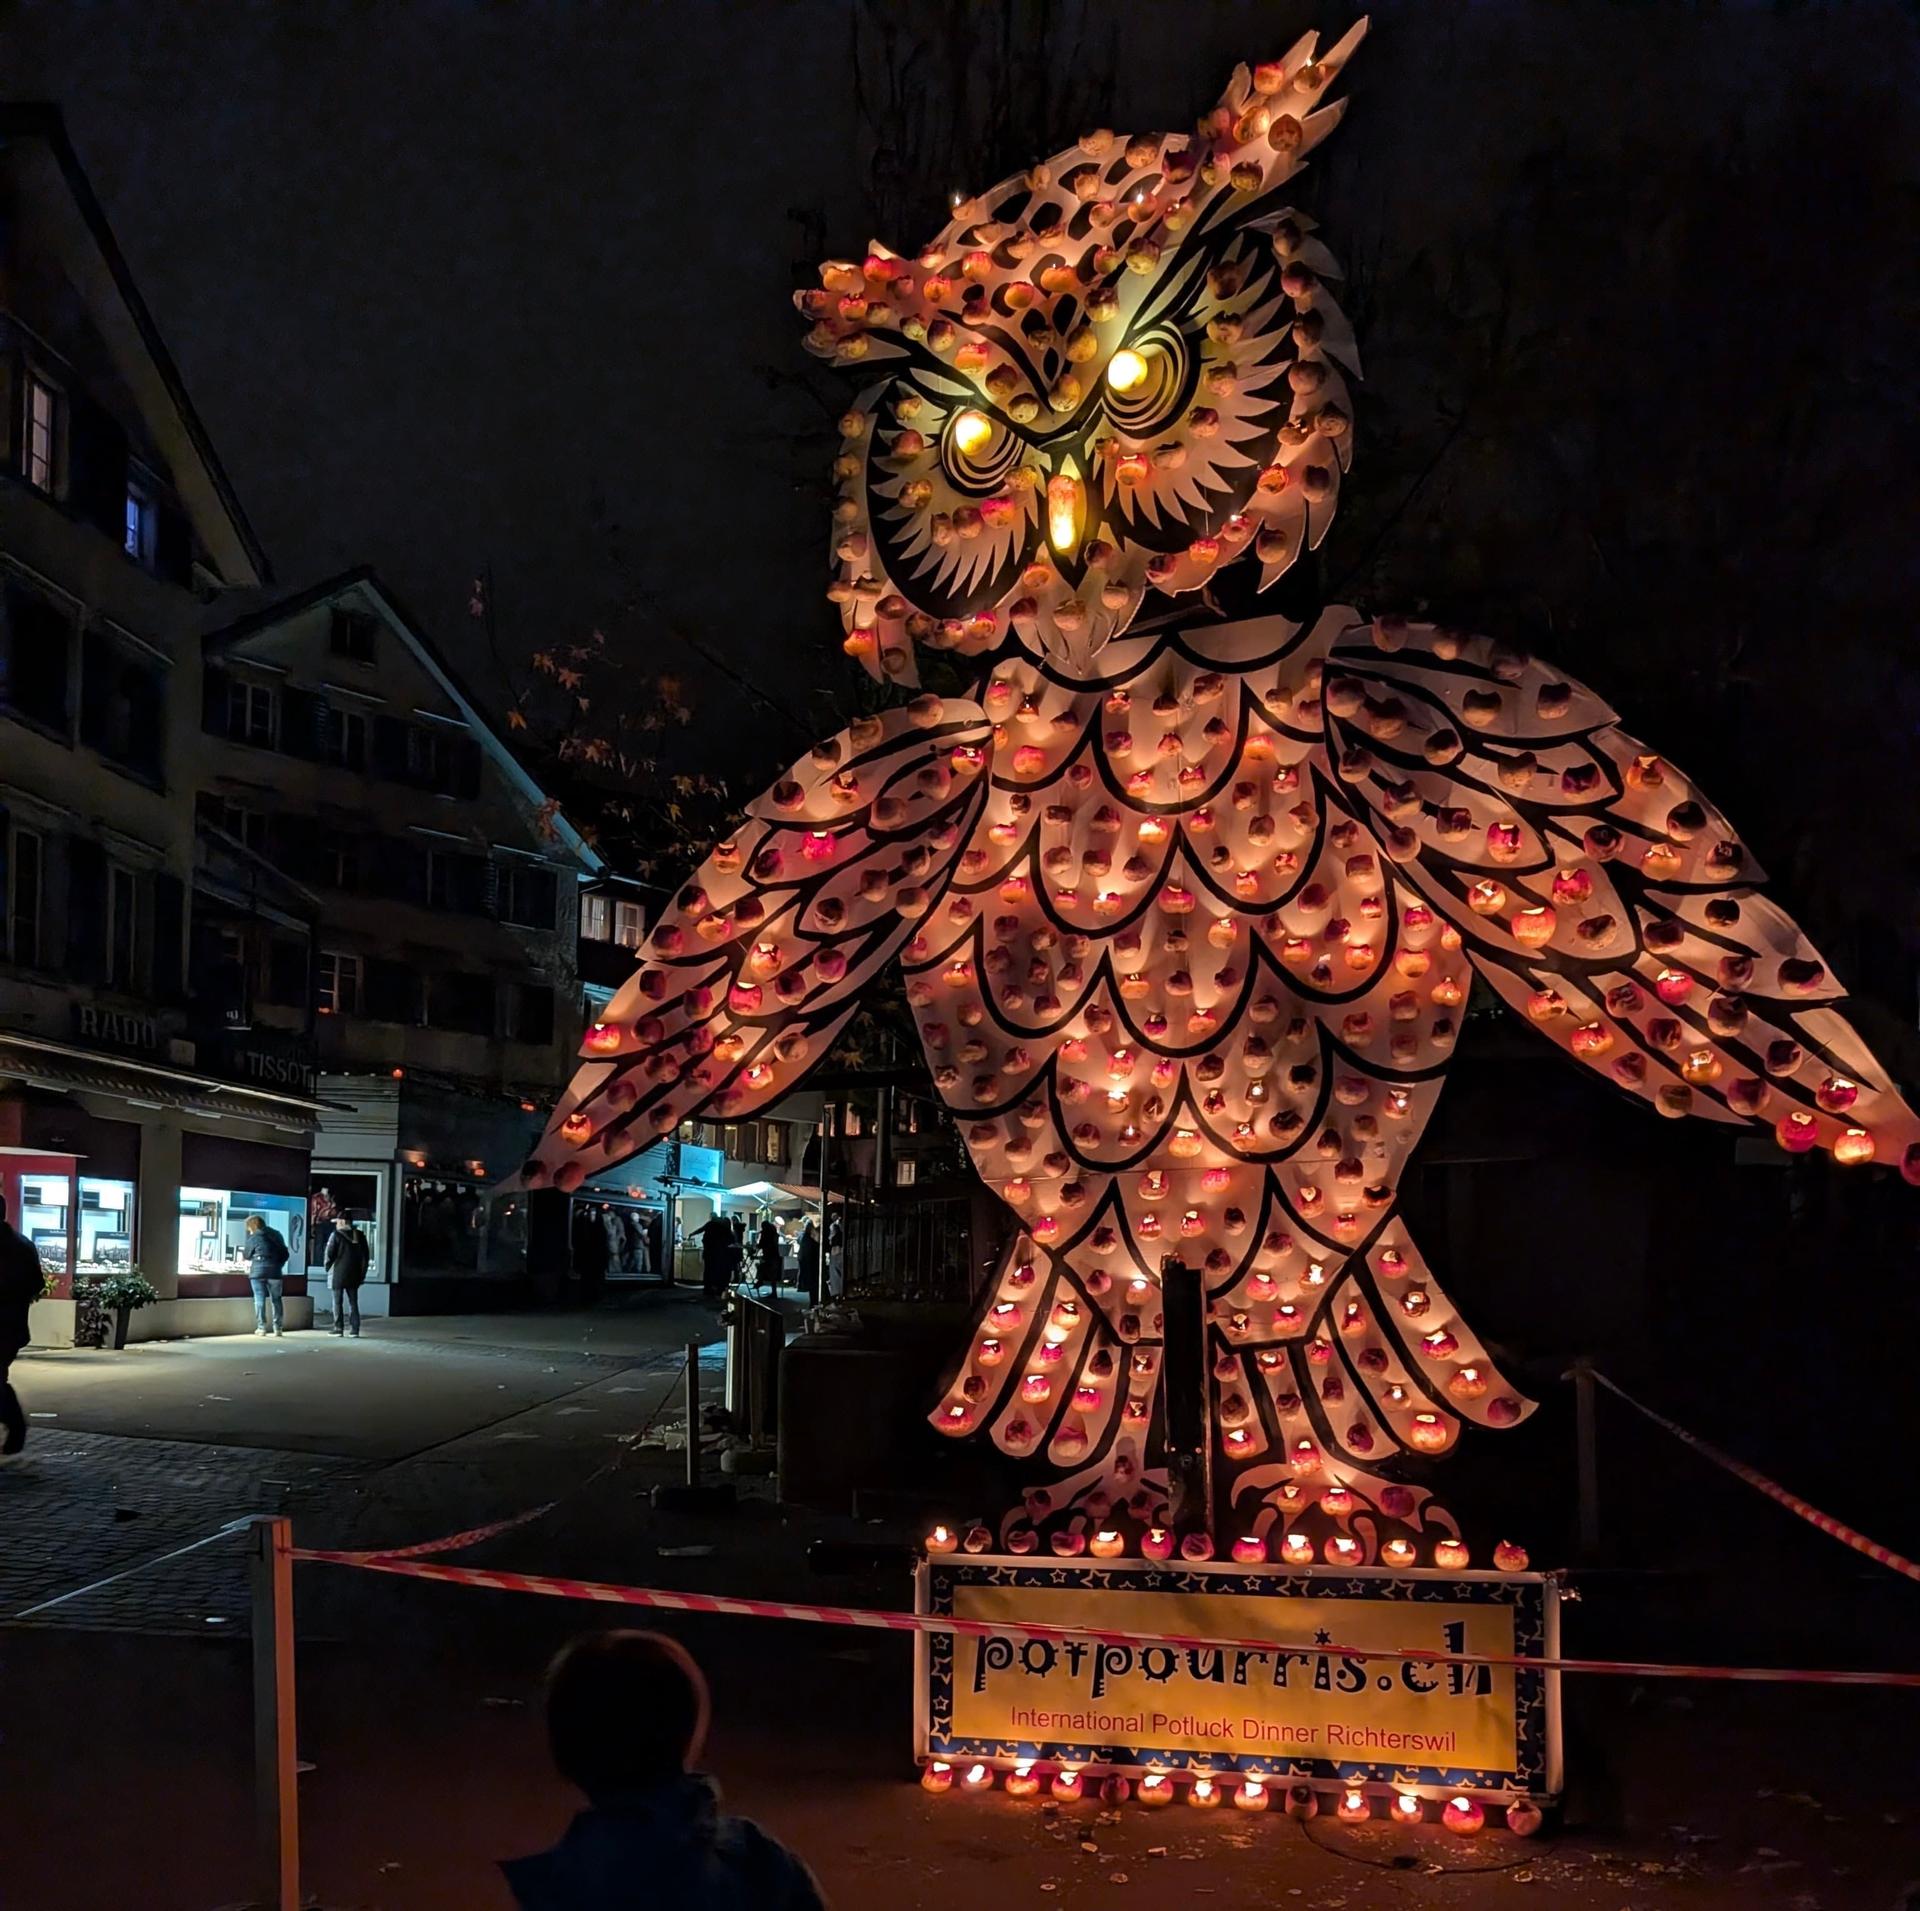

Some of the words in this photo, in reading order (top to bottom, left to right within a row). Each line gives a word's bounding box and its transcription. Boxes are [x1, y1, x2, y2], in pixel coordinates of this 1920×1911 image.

[80, 1006, 157, 1049] RADO
[246, 1050, 312, 1087] TISSOT
[973, 1621, 1492, 1699] potpourris.ch
[1011, 1705, 1144, 1733] International
[1152, 1713, 1235, 1738] Potluck
[1243, 1719, 1319, 1743] Dinner
[1327, 1724, 1456, 1752] Richterswil
